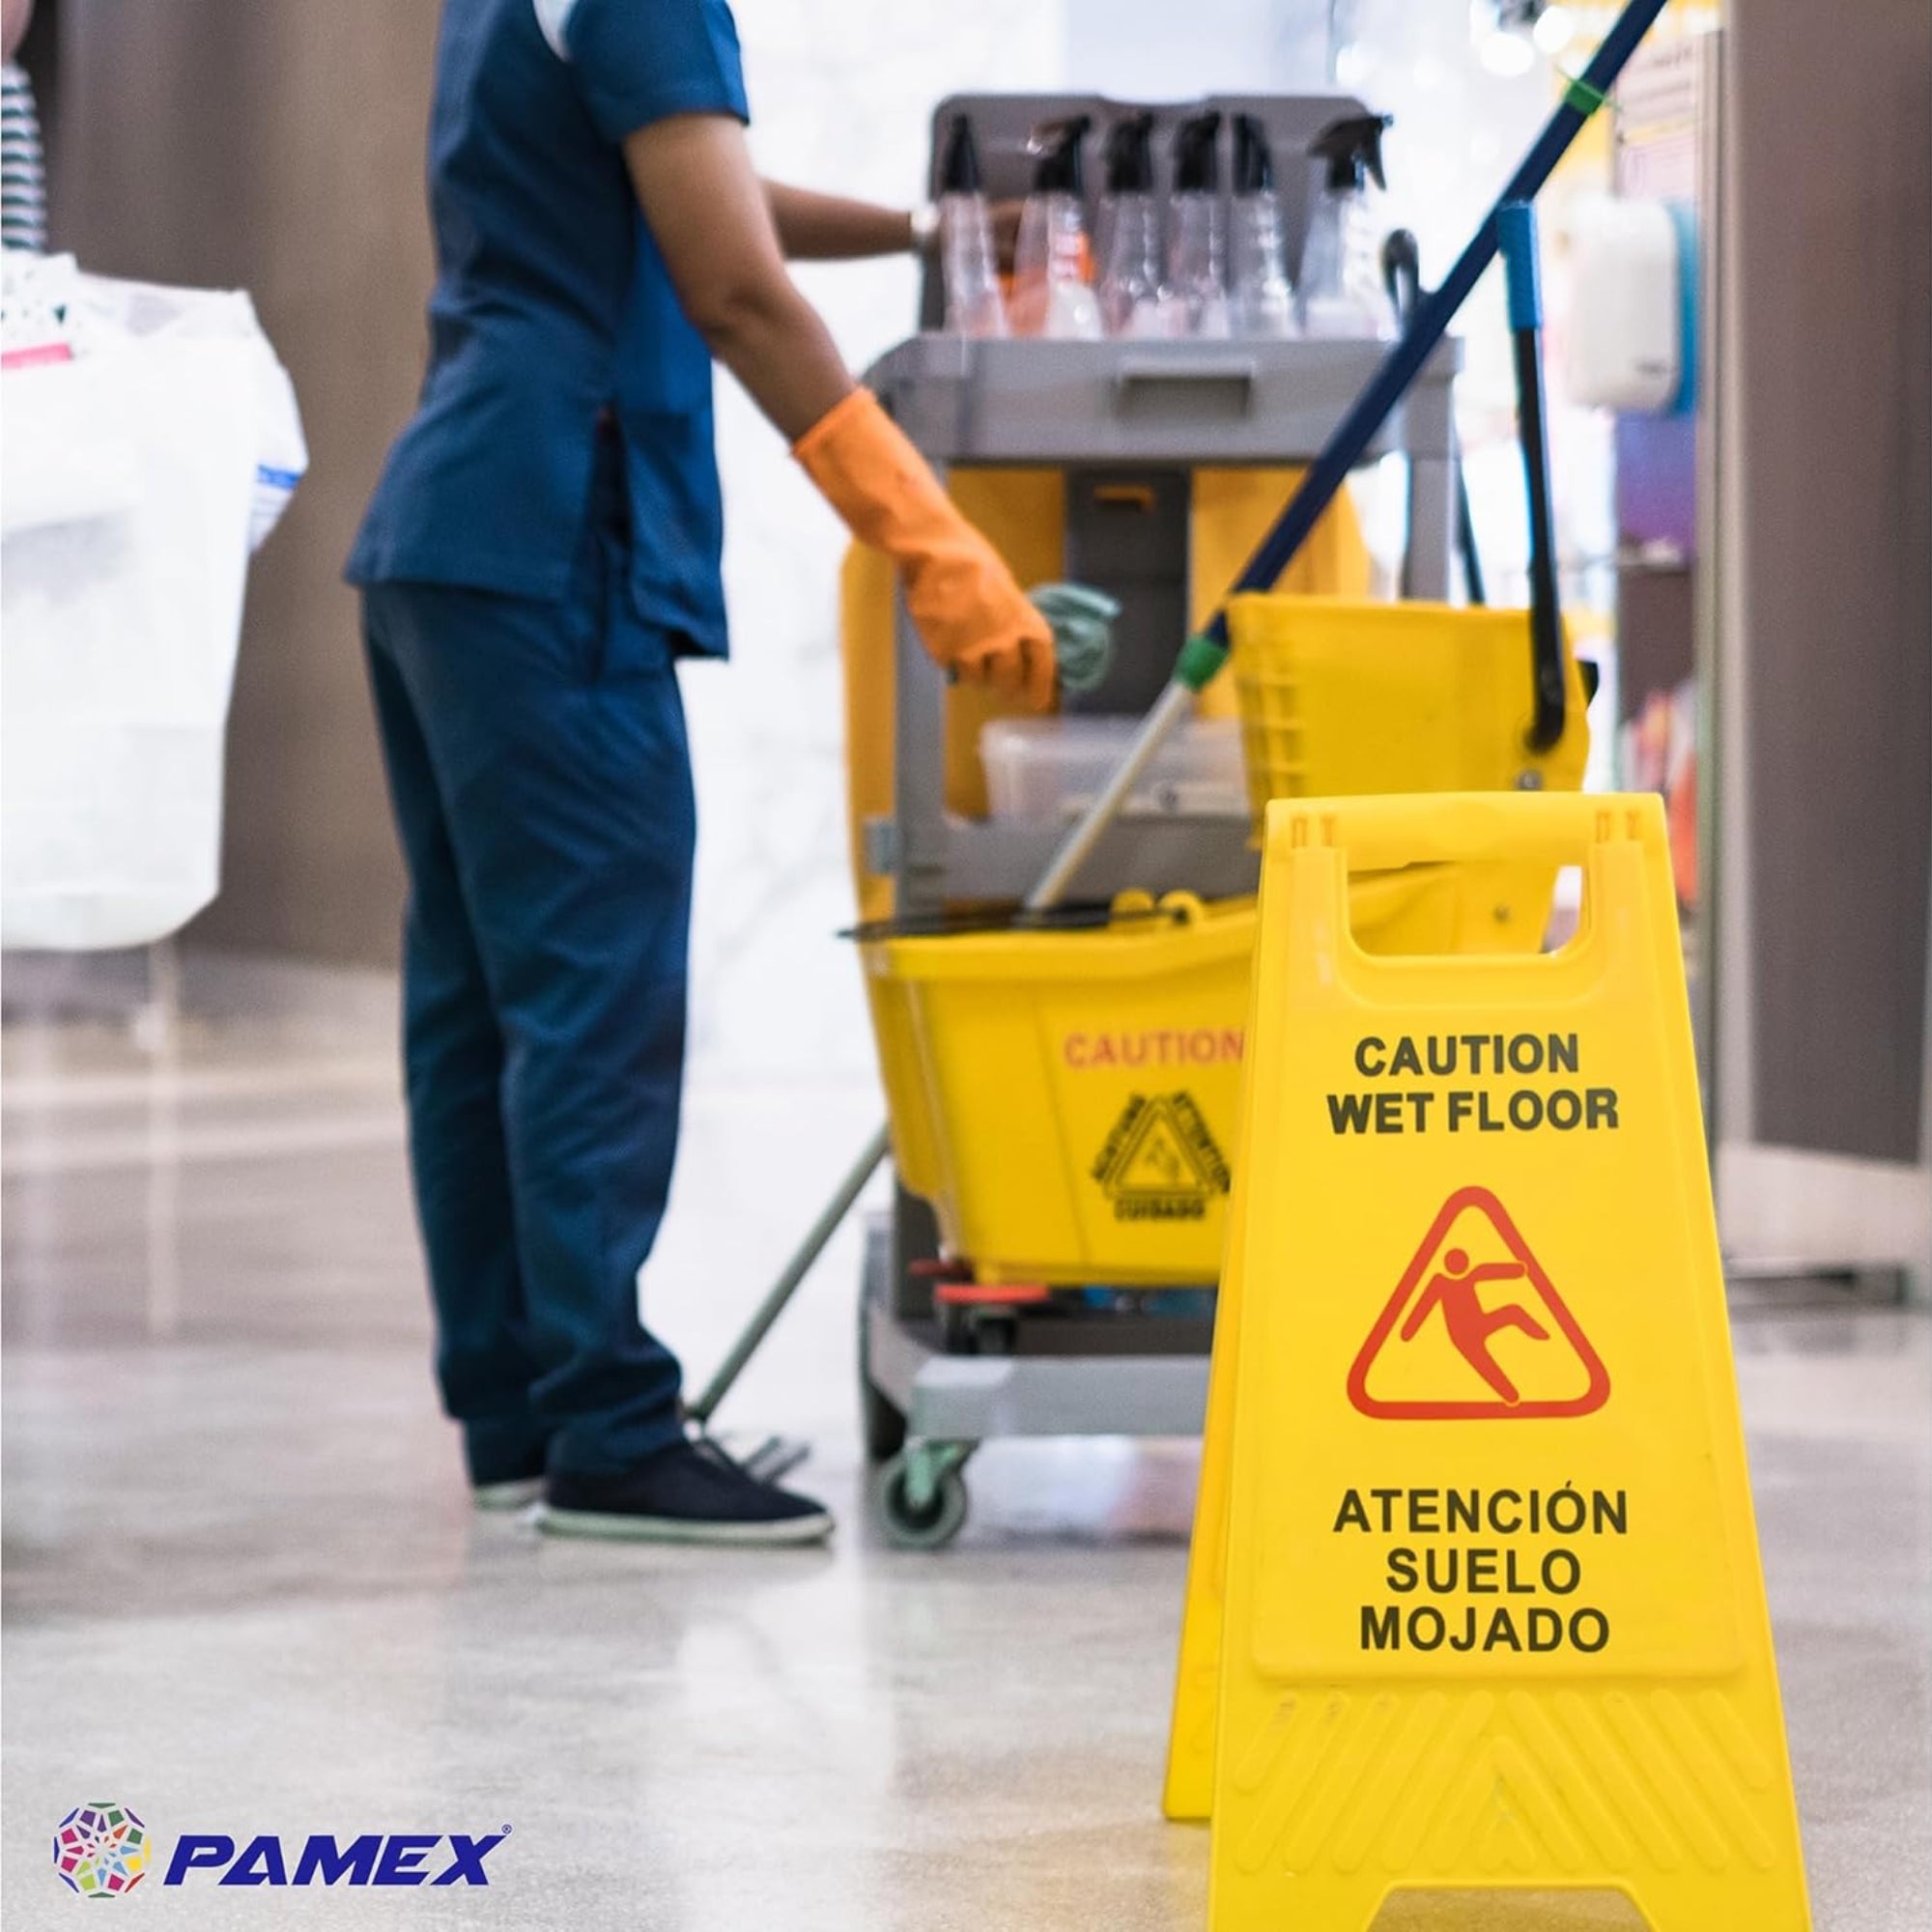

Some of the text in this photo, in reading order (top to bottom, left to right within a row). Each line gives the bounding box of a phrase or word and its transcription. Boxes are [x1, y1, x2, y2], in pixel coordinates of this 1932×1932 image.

[1064, 1030, 1244, 1067] CAUTION
[1354, 1033, 1579, 1077] CAUTION
[1326, 1088, 1619, 1135] WET FLOOR
[1332, 1480, 1628, 1535] ATENCIÓN
[1386, 1547, 1581, 1595] SUELO
[1360, 1605, 1610, 1653] MOJADO
